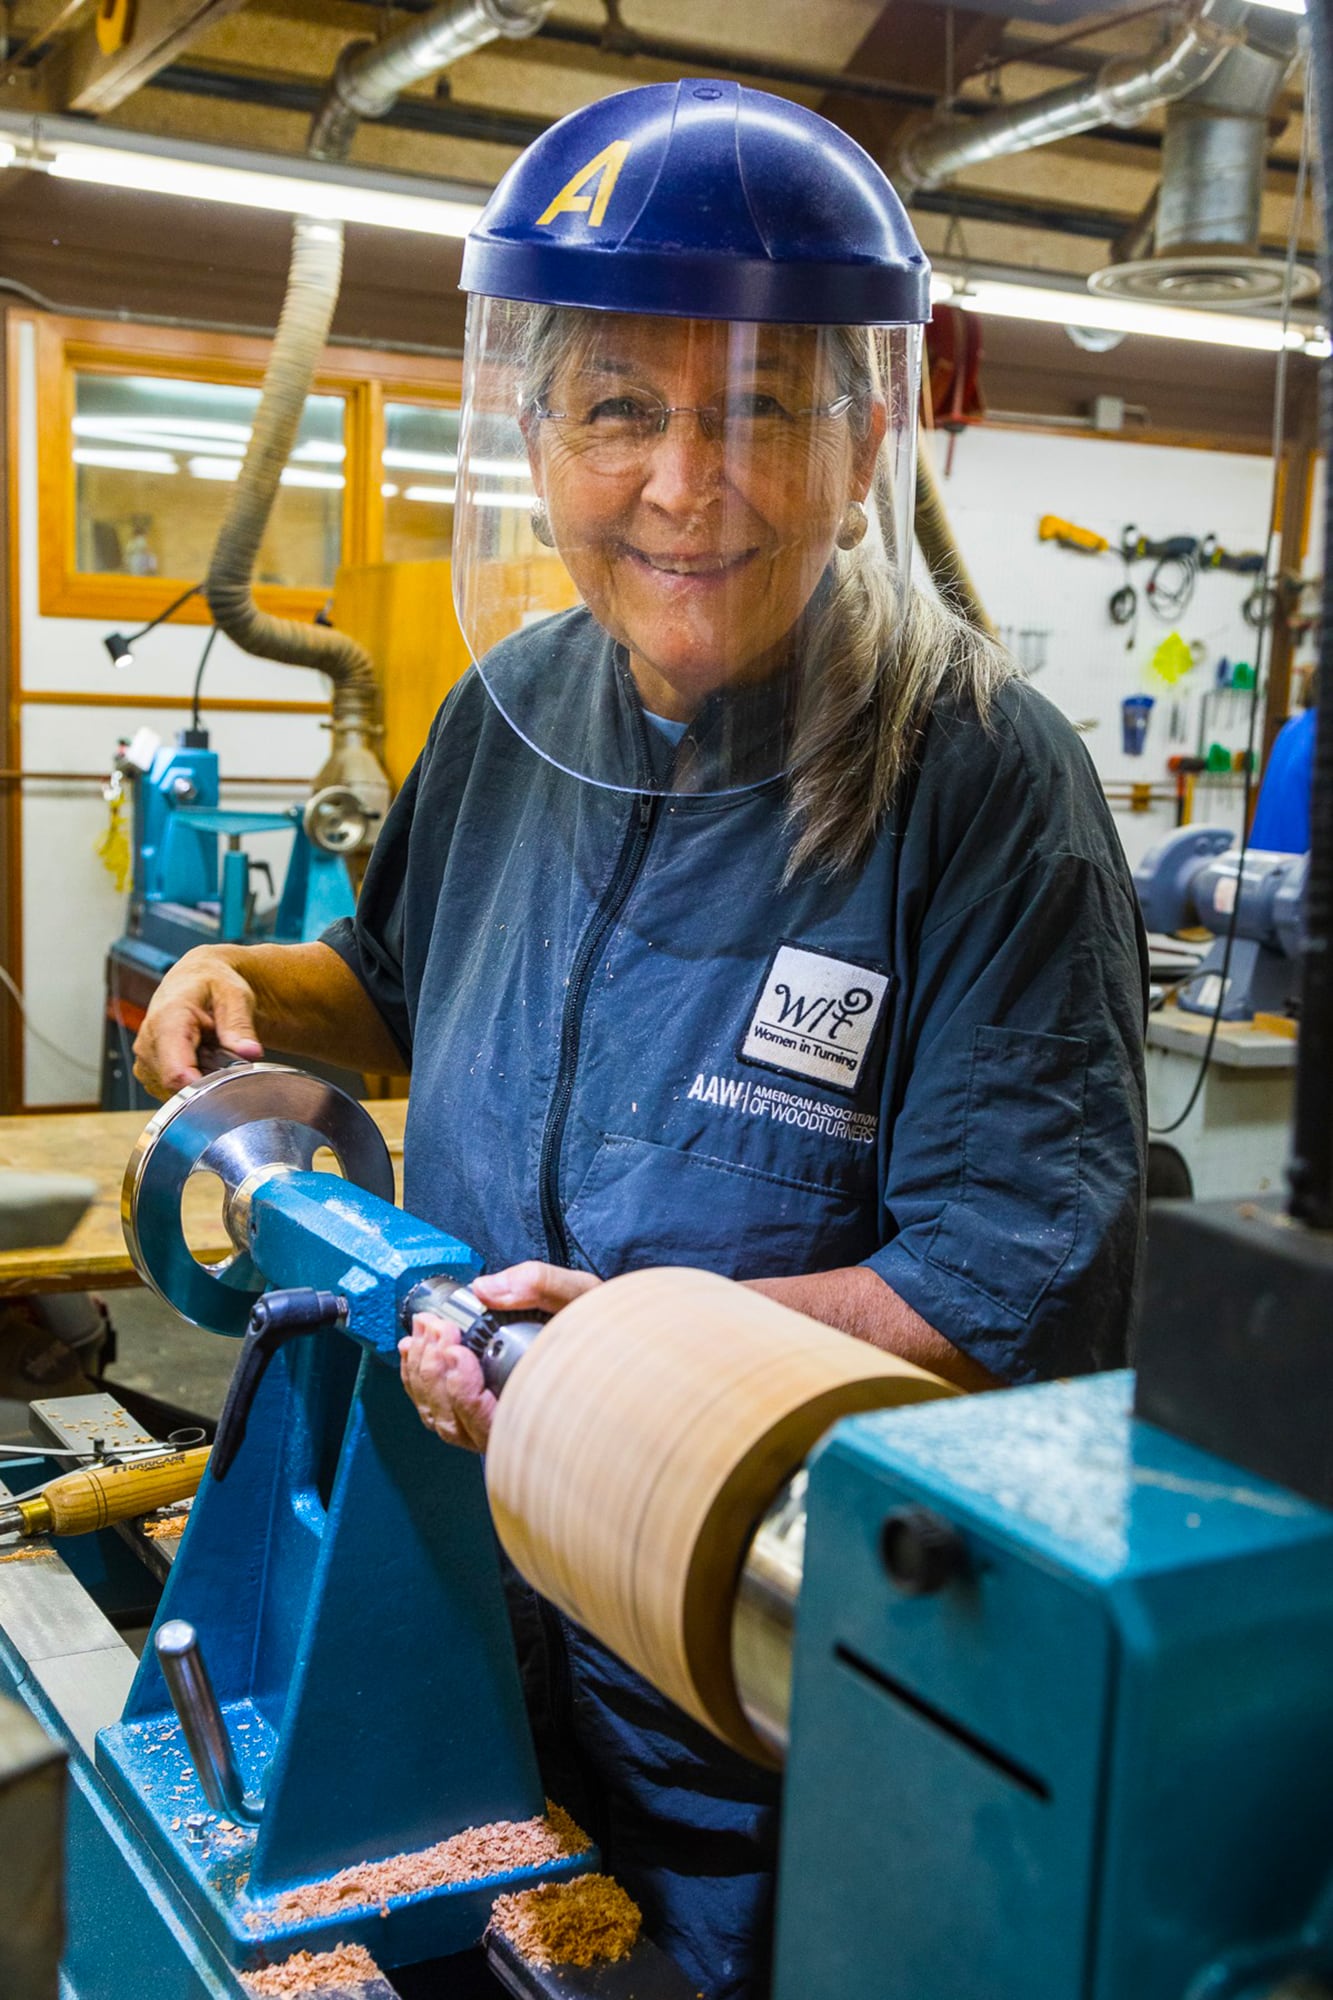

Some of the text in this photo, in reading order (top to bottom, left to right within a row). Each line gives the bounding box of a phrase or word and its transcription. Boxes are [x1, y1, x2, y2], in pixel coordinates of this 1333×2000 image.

[535, 139, 632, 227] A
[754, 1025, 858, 1071] Women in Turning
[687, 1073, 745, 1109] AAW
[753, 1085, 878, 1127] AMERICAN ASSOCIATION
[750, 1097, 876, 1144] OF WOODTURNERS
[112, 1452, 187, 1474] HURRICANE
